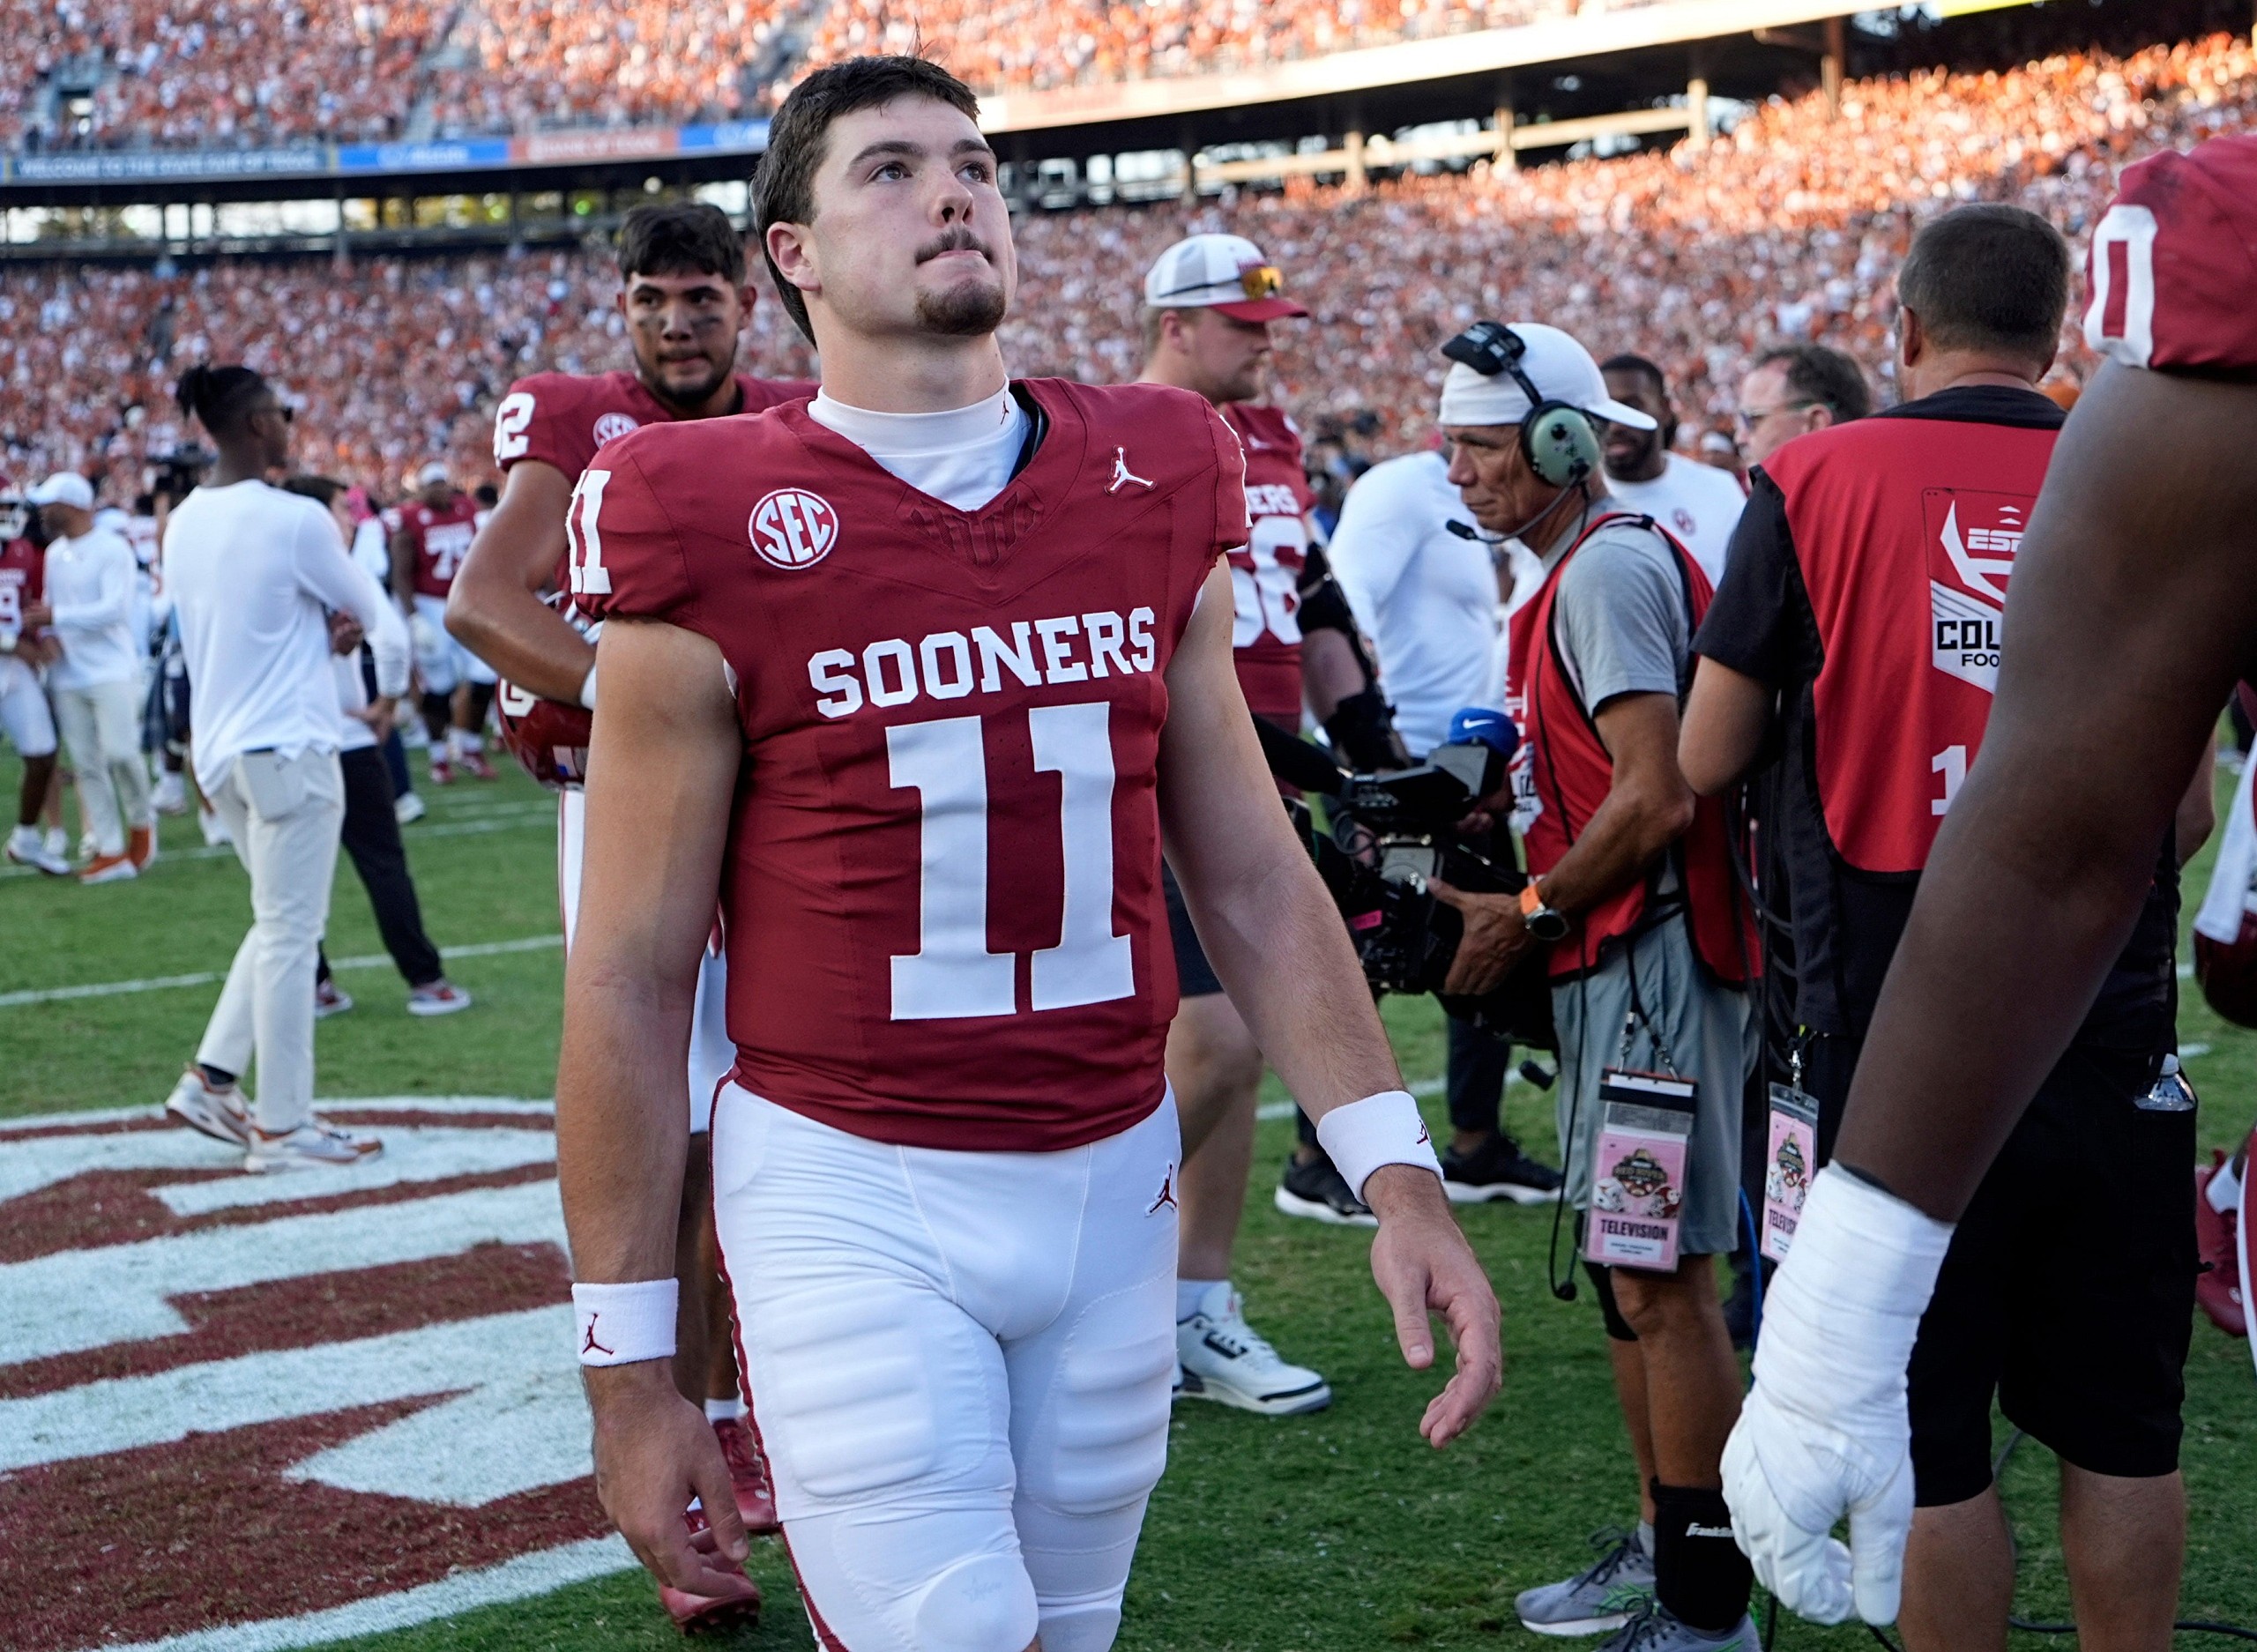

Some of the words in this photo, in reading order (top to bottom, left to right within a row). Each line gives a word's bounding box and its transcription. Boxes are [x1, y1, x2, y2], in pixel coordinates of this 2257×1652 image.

[755, 492, 831, 563] SEC
[1967, 527, 2026, 553] ESP
[1937, 621, 2000, 651] COL
[807, 606, 1155, 719] SOONERS
[1962, 653, 2000, 667] FOO
[884, 701, 1136, 1021] 11
[1600, 1218, 1669, 1241] TELEVISION
